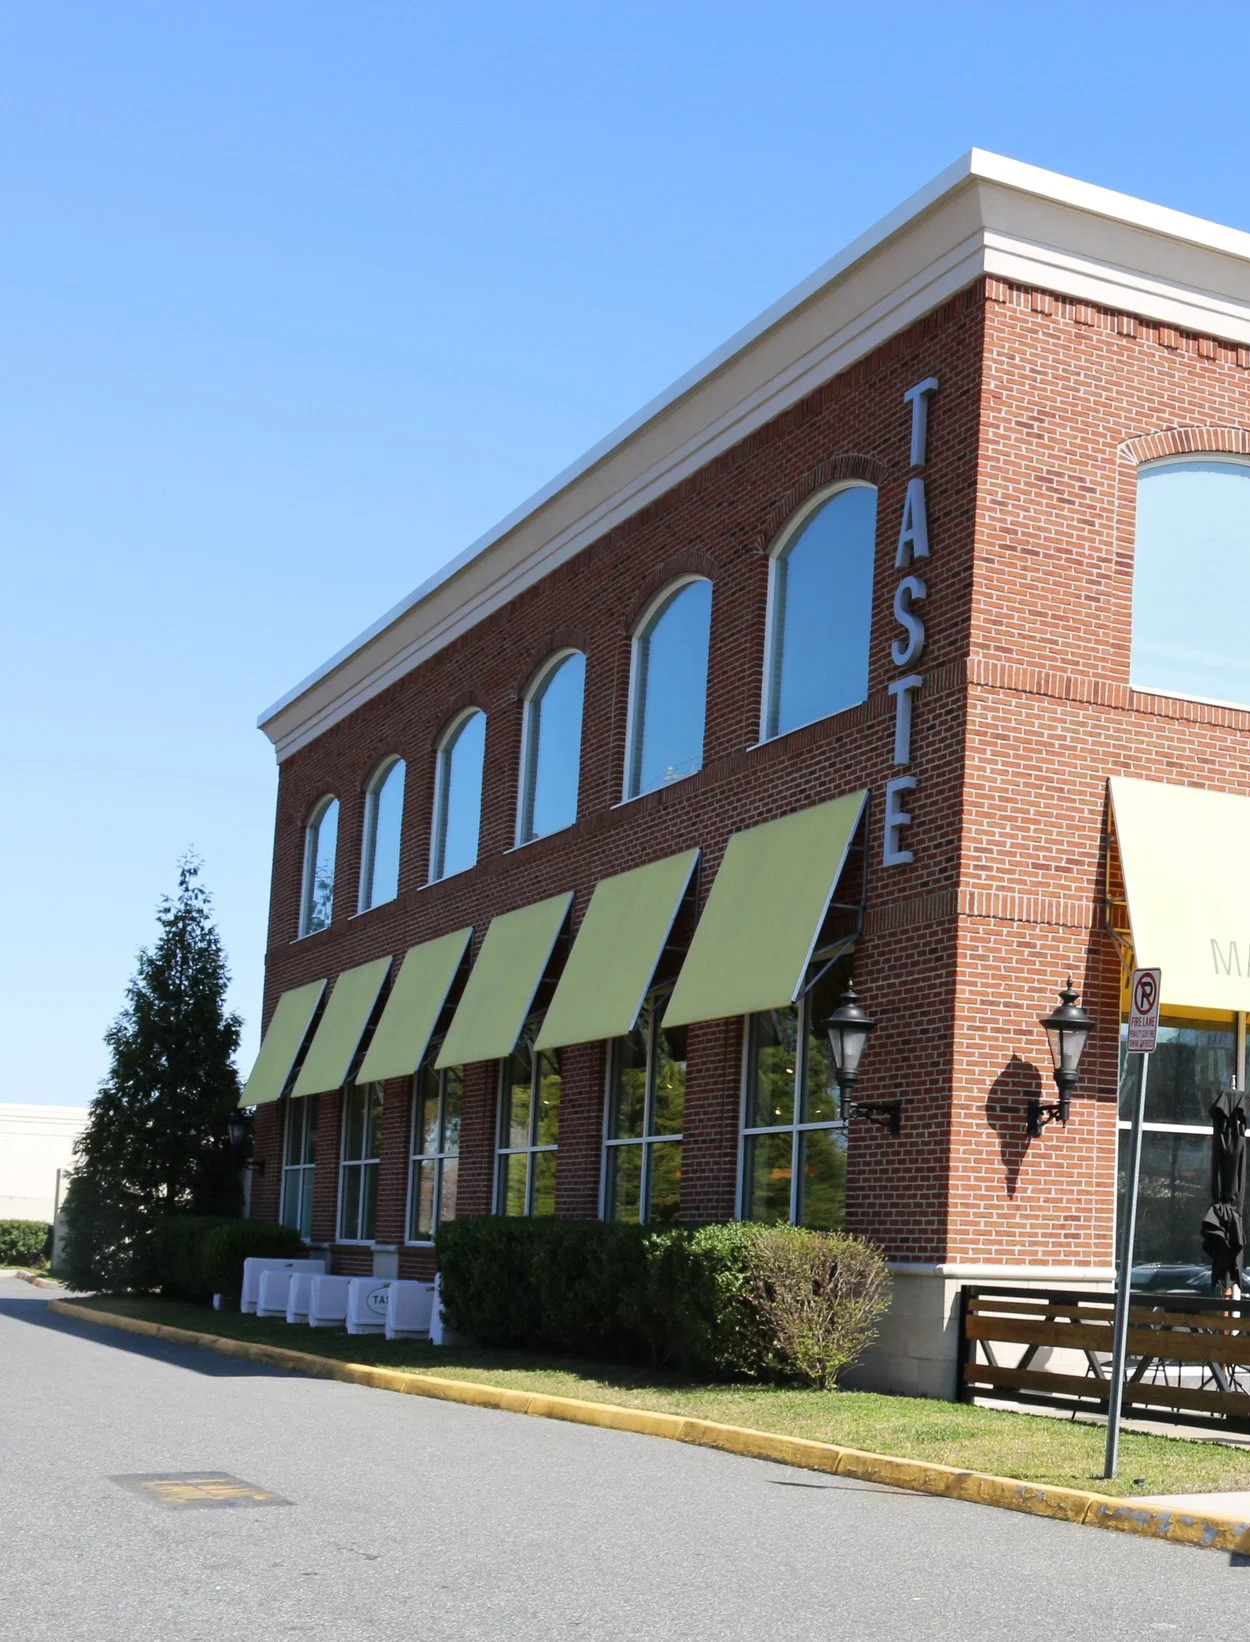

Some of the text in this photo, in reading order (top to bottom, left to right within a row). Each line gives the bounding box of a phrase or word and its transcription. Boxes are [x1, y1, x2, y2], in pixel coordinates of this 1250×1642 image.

[883, 376, 938, 868] TASTE
[1131, 1016, 1156, 1027] FIRE LANE
